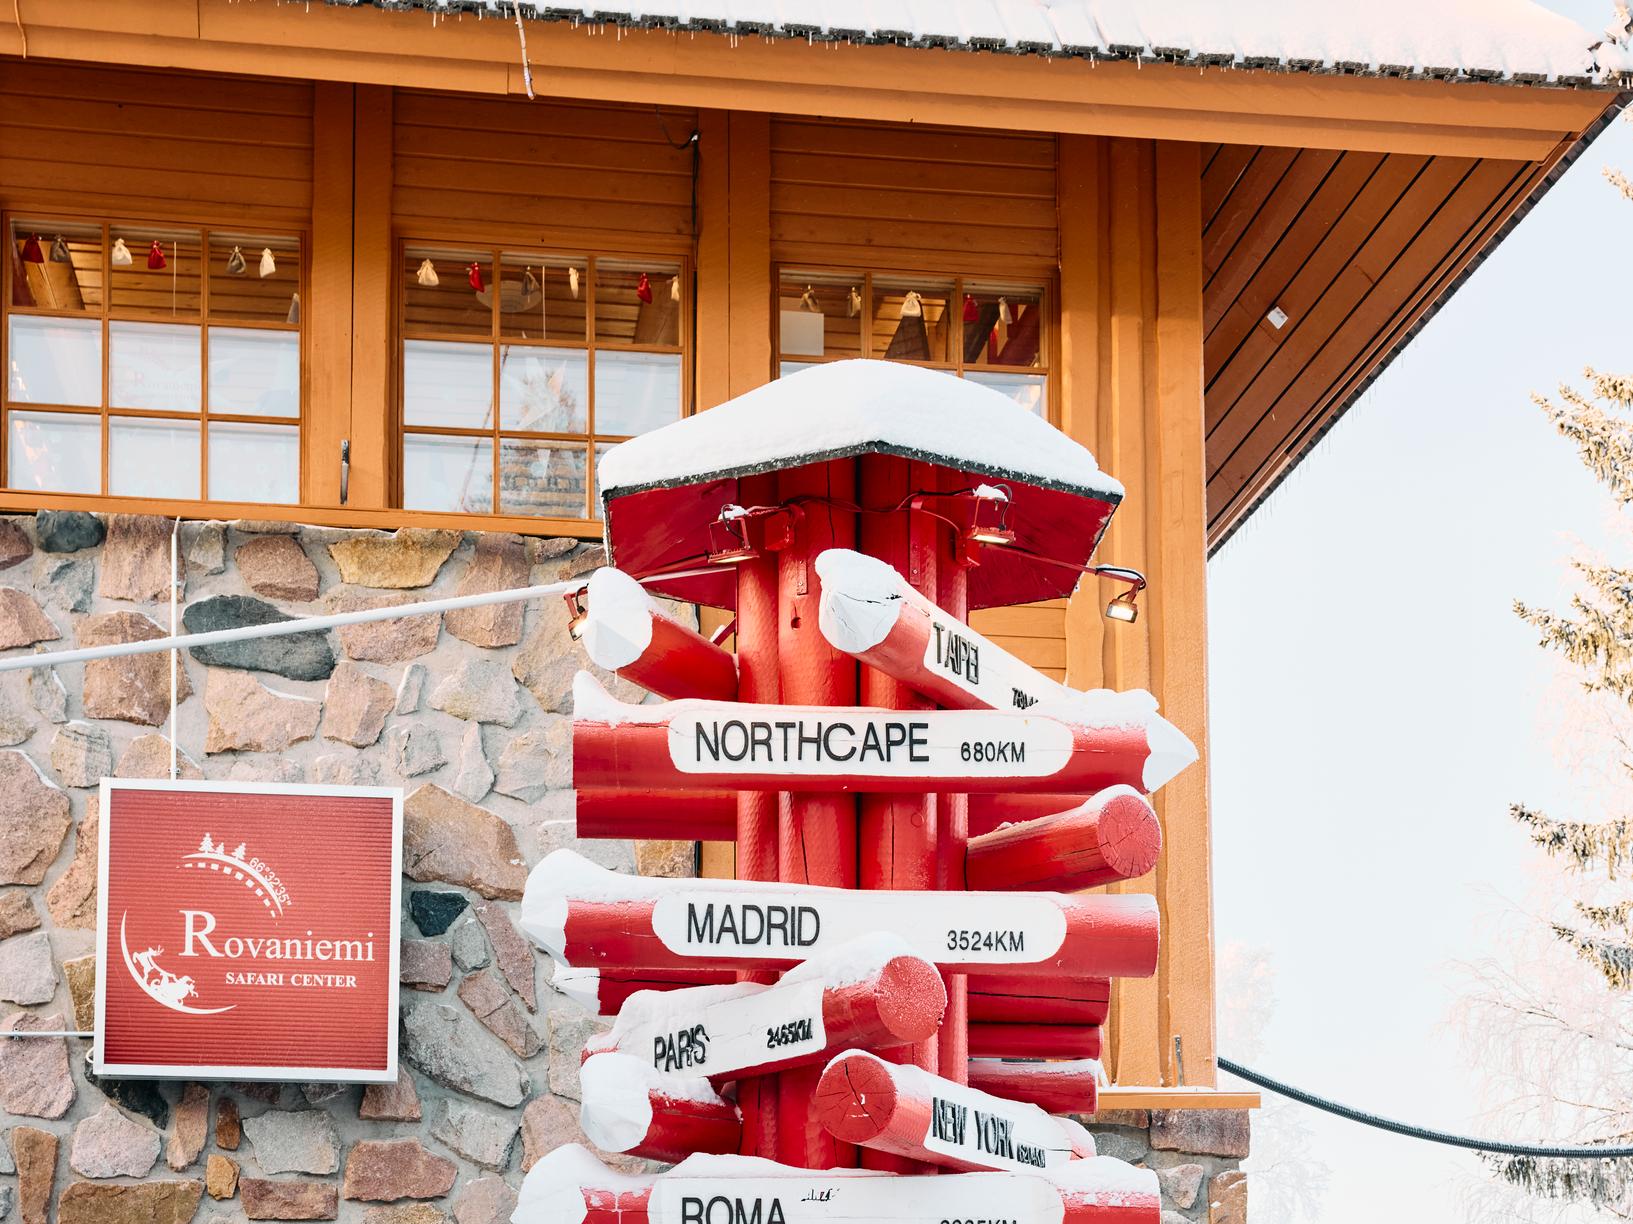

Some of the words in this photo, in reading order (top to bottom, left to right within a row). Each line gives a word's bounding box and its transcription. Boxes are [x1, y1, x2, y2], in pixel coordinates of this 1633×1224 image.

[932, 621, 979, 685] TAIPEI
[695, 720, 930, 763] NORTHCAPE
[960, 741, 1026, 763] 680KM
[178, 909, 375, 962] Rovaniemi
[687, 903, 821, 947] MADRID
[947, 930, 1025, 951] 3524KM
[225, 972, 284, 986] SAFARI
[290, 973, 357, 988] CENTER
[653, 1023, 710, 1073] PARIS
[932, 1097, 967, 1146] NEW
[974, 1110, 1015, 1160] YORK
